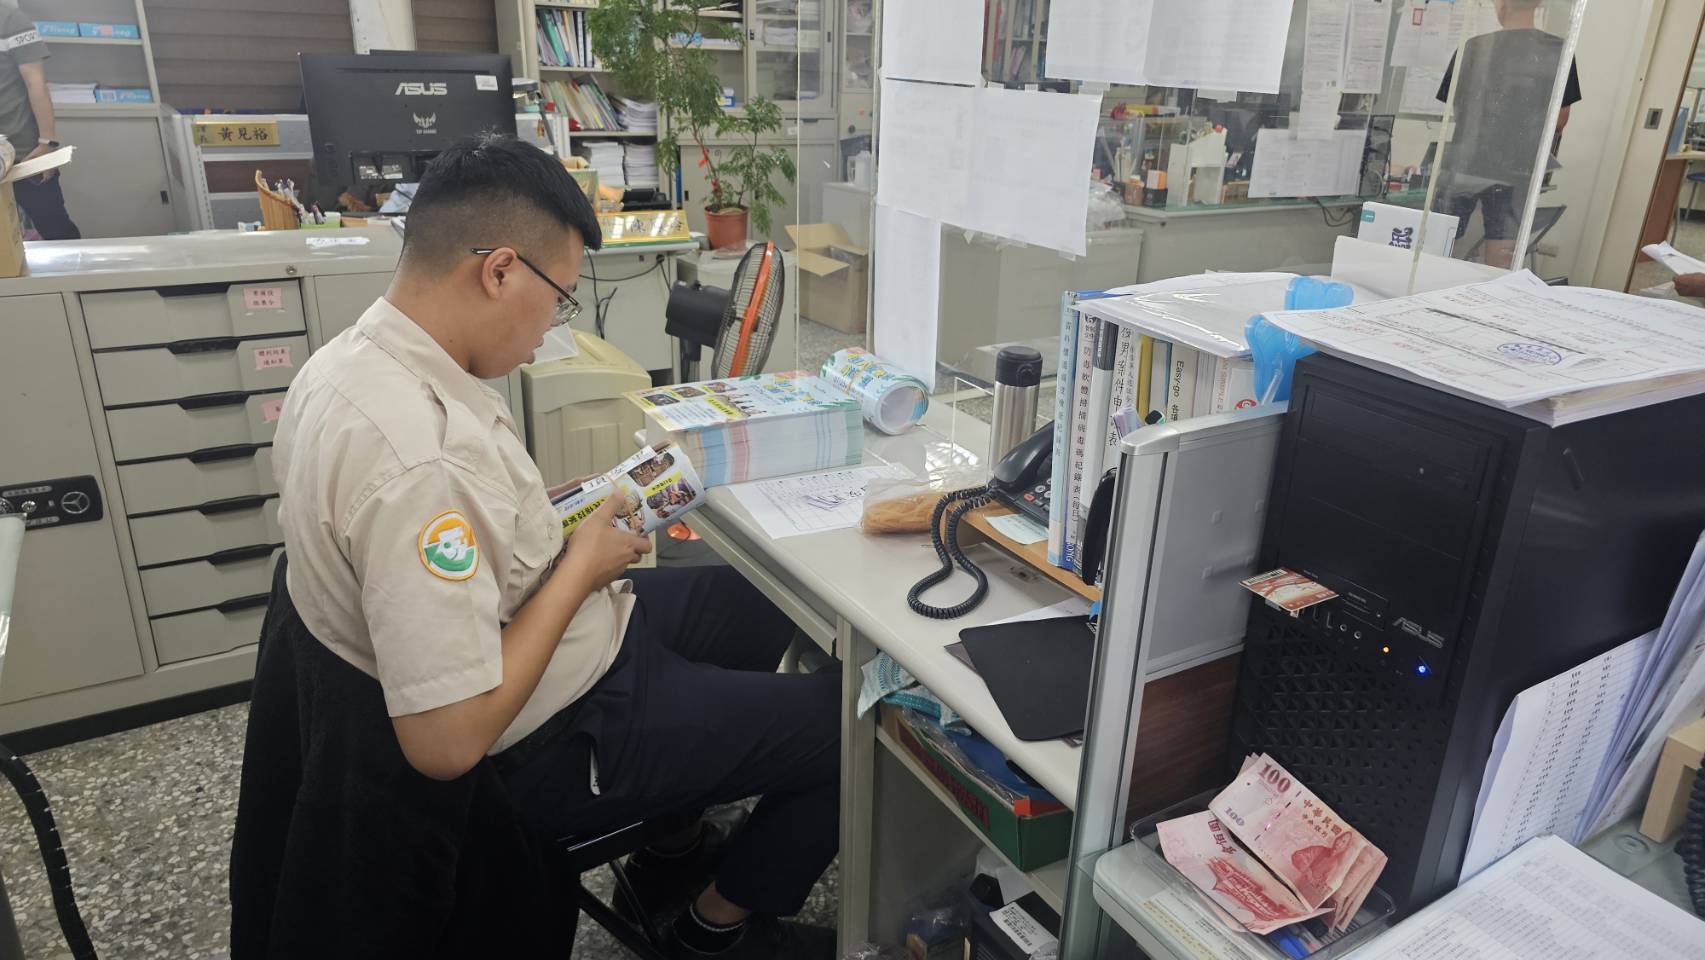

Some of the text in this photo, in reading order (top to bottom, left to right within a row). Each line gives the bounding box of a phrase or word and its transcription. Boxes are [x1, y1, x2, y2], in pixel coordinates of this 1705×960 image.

[395, 82, 448, 96] ASUS
[1109, 327, 1131, 446] 役男案件申表
[1173, 360, 1184, 398] Easy-go
[1392, 616, 1445, 649] ASUS
[1258, 763, 1291, 793] 100
[1223, 807, 1245, 826] 100
[1303, 799, 1342, 836] 中華民國
